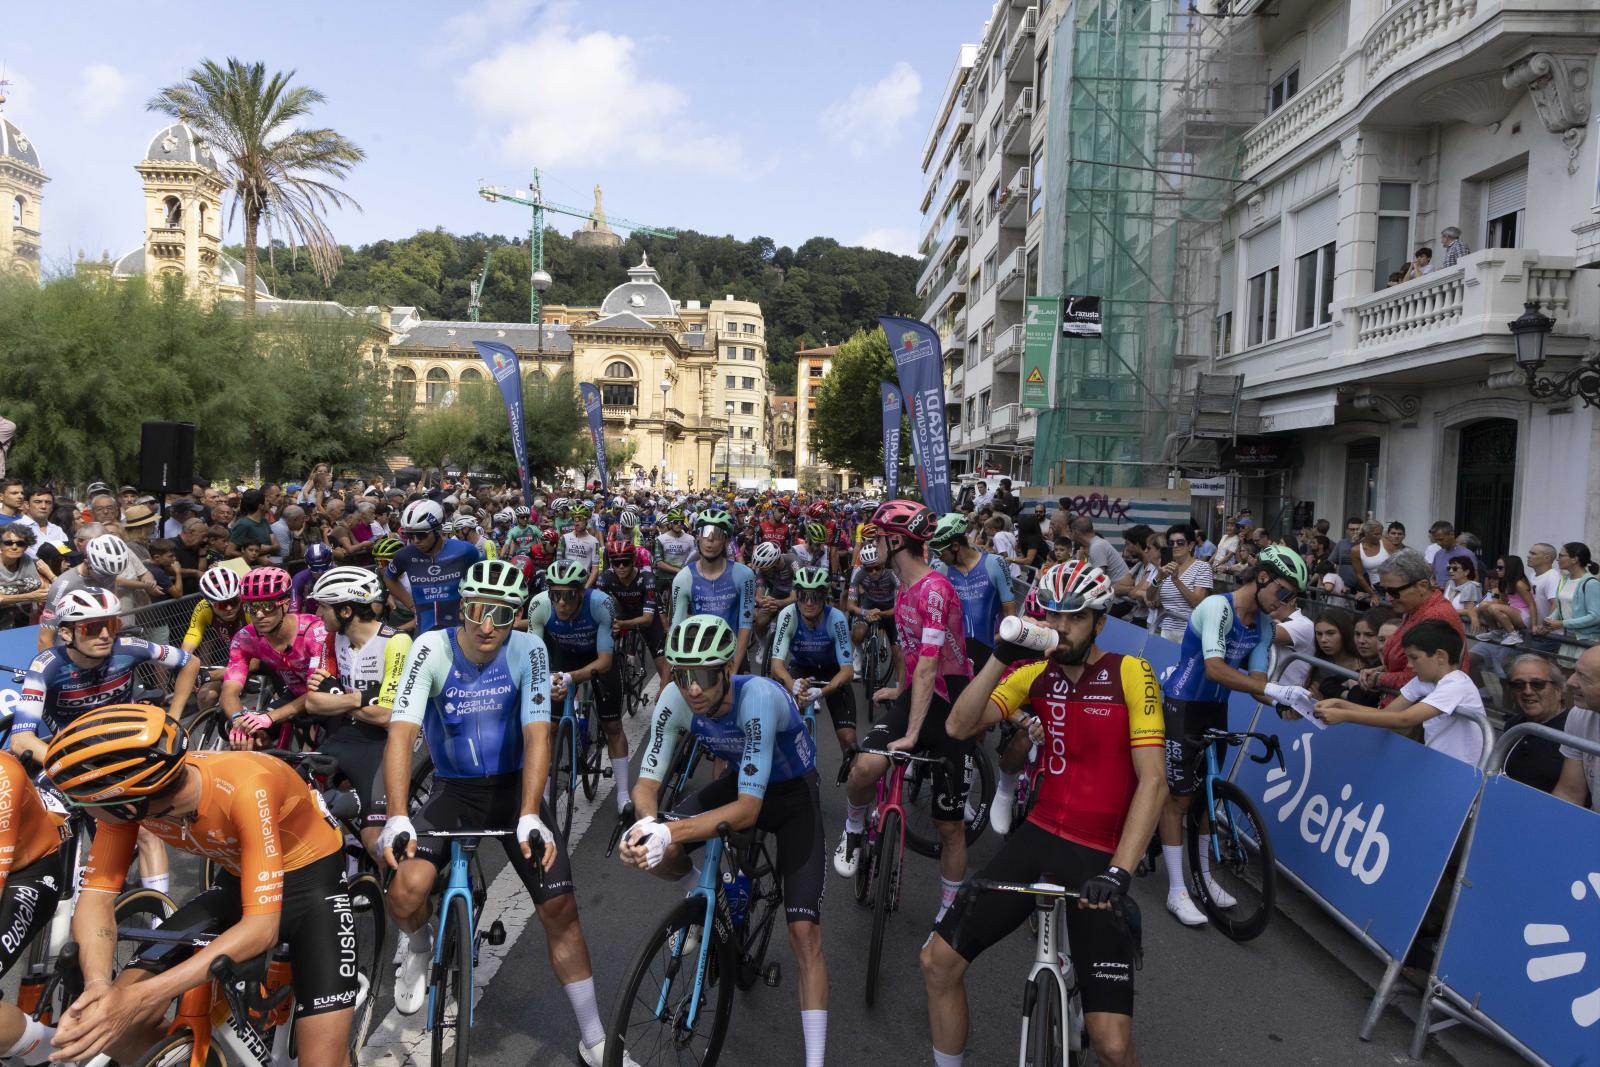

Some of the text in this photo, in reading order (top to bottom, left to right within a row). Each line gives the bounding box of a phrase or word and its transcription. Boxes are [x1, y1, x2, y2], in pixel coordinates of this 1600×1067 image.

[908, 514, 924, 531] POC
[410, 571, 460, 583] Groupama
[347, 587, 366, 597] uvex
[423, 586, 442, 594] FDJ
[406, 645, 431, 696] DECATHLON
[529, 649, 539, 692] MONDIALE
[536, 647, 546, 684] AG2R LA
[19, 694, 43, 703] OUDAL
[59, 683, 131, 706] SOUDAL
[458, 685, 512, 698] DECATHLON
[1141, 661, 1159, 716] ofidis
[457, 704, 503, 716] MONDIALE
[458, 700, 481, 709] AG2R
[653, 706, 672, 754] DECATHLON
[752, 717, 762, 754] AG2R LA
[1046, 679, 1069, 775] Cofidis
[1174, 769, 1184, 782] LA
[255, 788, 279, 858] euskaltel
[1300, 784, 1390, 885] eitb
[548, 881, 561, 889] VAN
[259, 893, 283, 905] Oran
[1, 884, 39, 954] euskaltel
[325, 893, 357, 978] euskaltel
